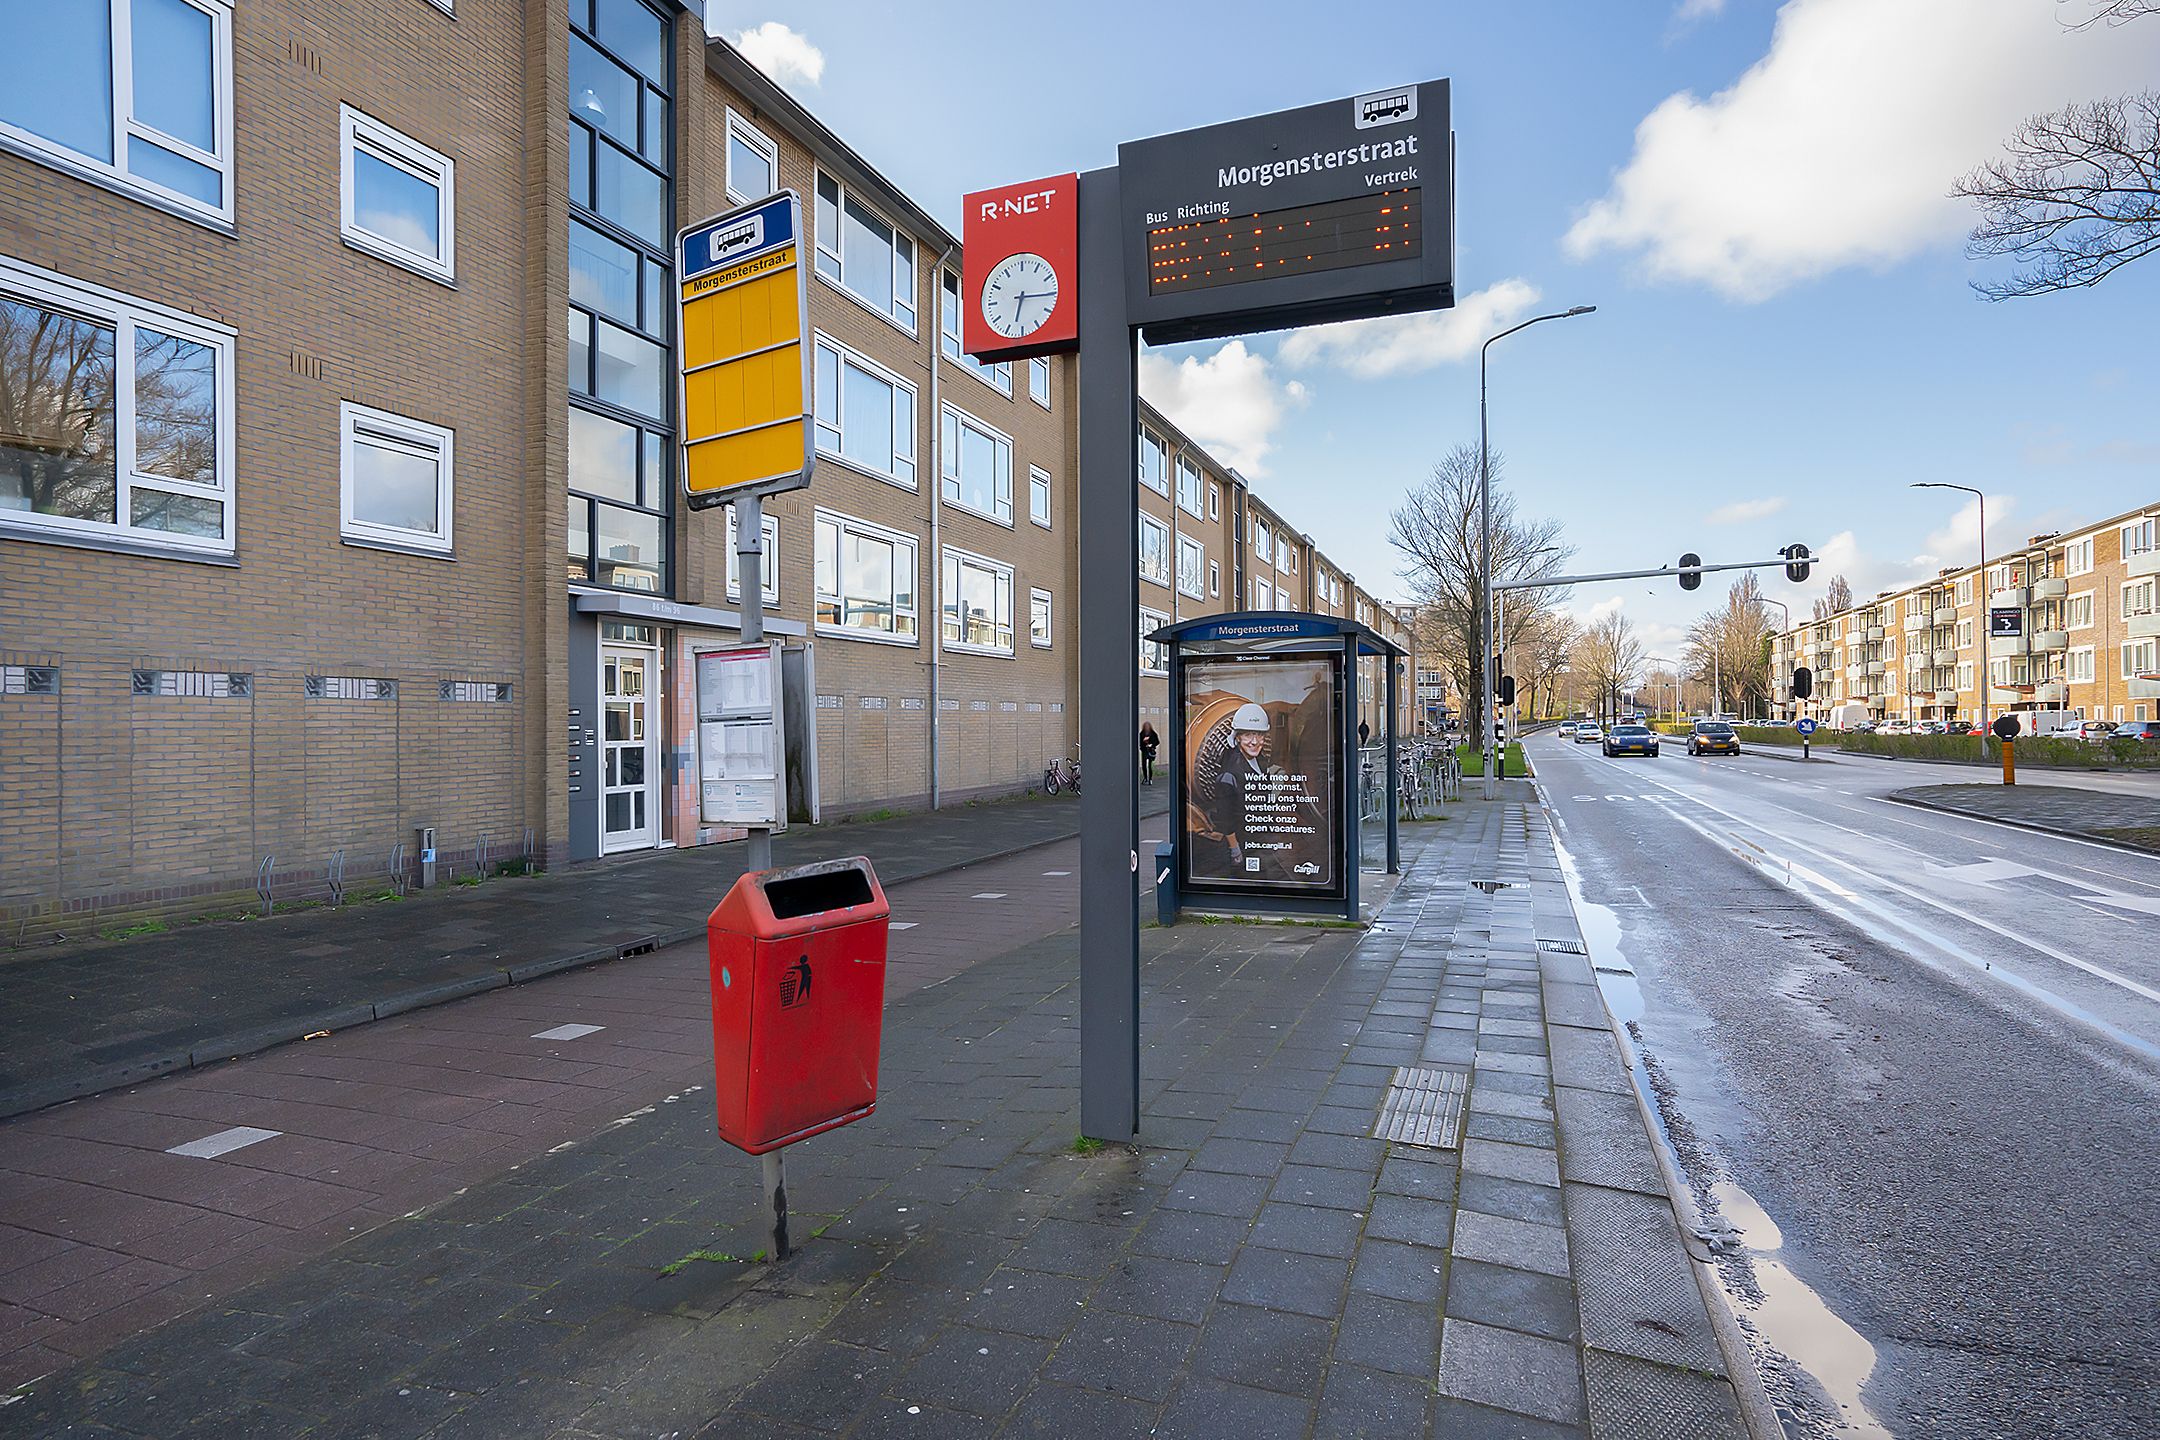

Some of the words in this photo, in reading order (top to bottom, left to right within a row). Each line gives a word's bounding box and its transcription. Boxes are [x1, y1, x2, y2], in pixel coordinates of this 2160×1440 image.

[1218, 134, 1418, 188] Morgensterstraat
[1364, 166, 1418, 187] Vertrek
[1146, 210, 1168, 225] Bus
[1177, 200, 1230, 219] Richting
[693, 252, 787, 292] Morgensterstraat
[1218, 624, 1299, 636] Morgensterstraat
[1244, 773, 1267, 781] Werk
[1290, 774, 1307, 782] aan
[1244, 783, 1256, 791] de
[1258, 783, 1302, 791] toekomst.
[1244, 794, 1266, 802] Kom
[1267, 794, 1276, 803] jij
[1244, 804, 1297, 812] versterken?
[1244, 814, 1274, 823] Check
[1244, 825, 1267, 833] open
[1269, 825, 1316, 833] vacatures:
[1244, 841, 1292, 850] jobs.cargill.nl
[1293, 863, 1320, 875] Cargill
